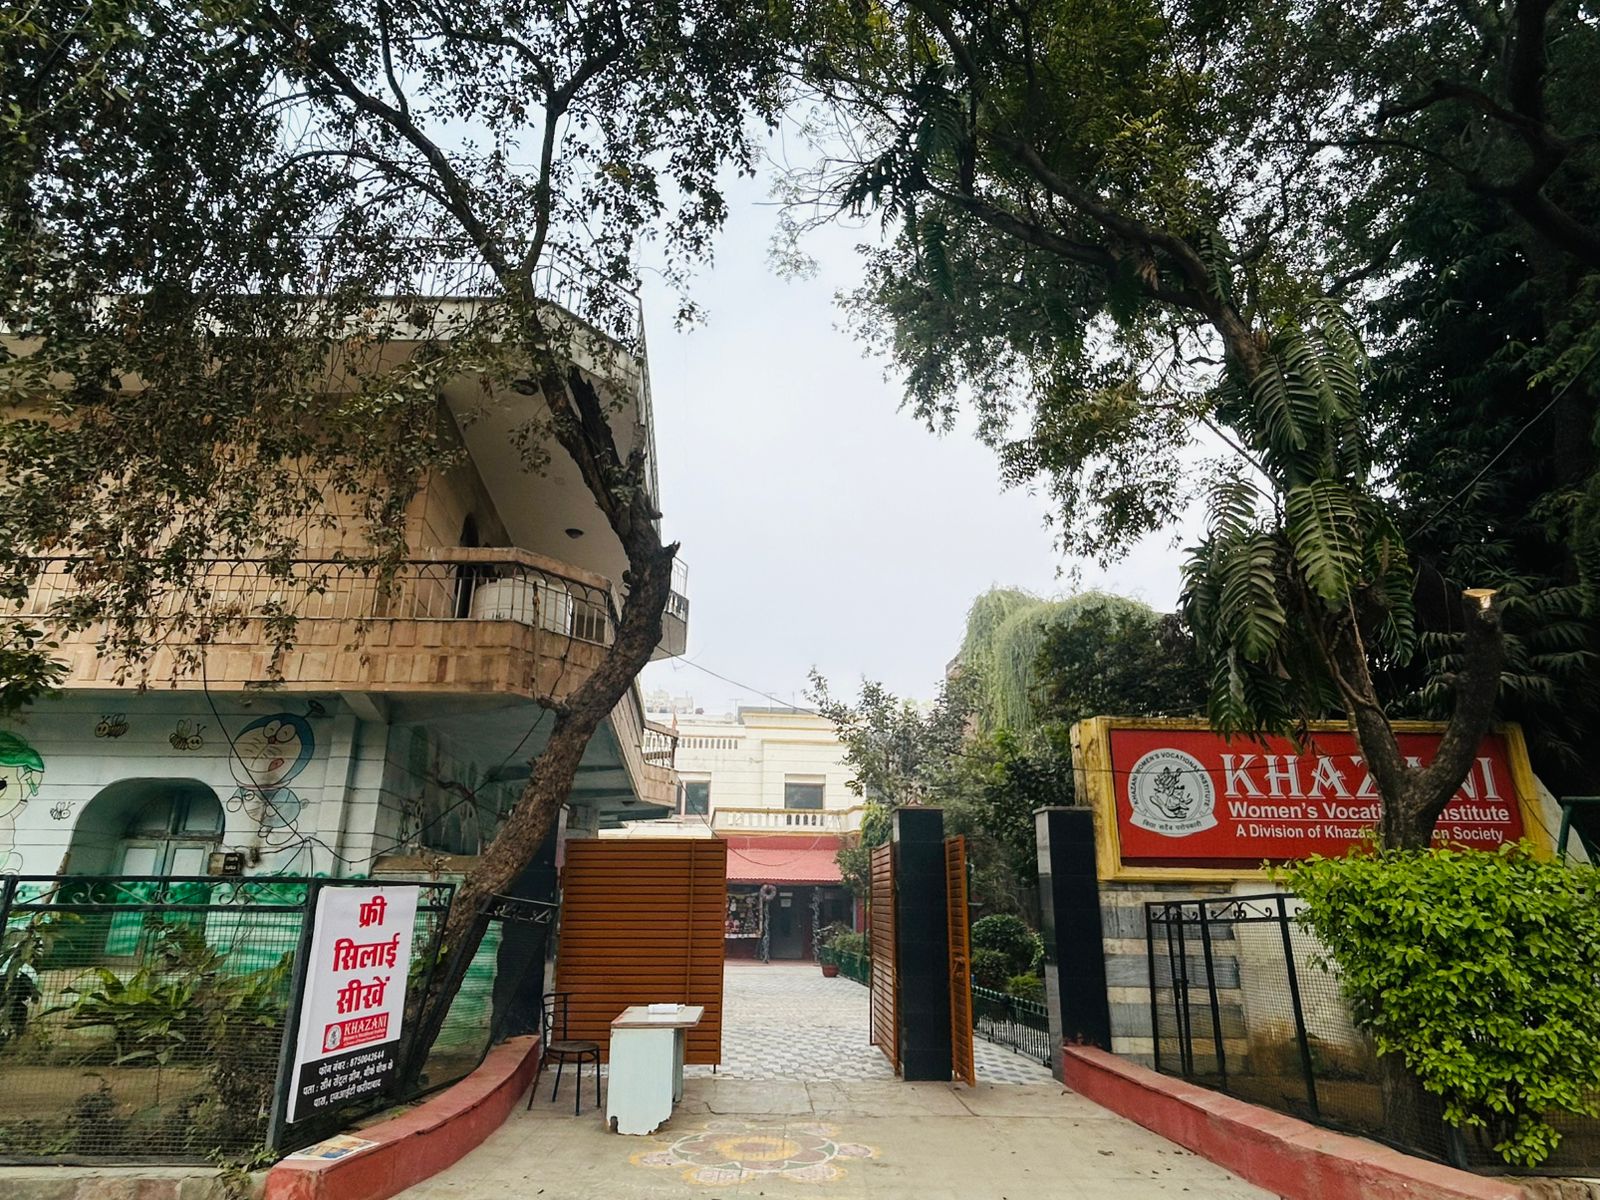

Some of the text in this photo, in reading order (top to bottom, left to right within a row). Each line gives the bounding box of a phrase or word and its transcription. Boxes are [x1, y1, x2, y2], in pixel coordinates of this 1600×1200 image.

[1220, 754, 1503, 801] KHAZI
[1228, 801, 1510, 821] Women's Vocati nstitute
[1236, 823, 1247, 837] A
[1249, 824, 1303, 838] Division
[1307, 825, 1320, 838] of
[1453, 826, 1503, 843] Society
[359, 895, 388, 928] फ्री
[333, 932, 400, 972] सिलाई
[336, 976, 390, 1014] सीखें
[344, 1015, 387, 1036] KHAZANI
